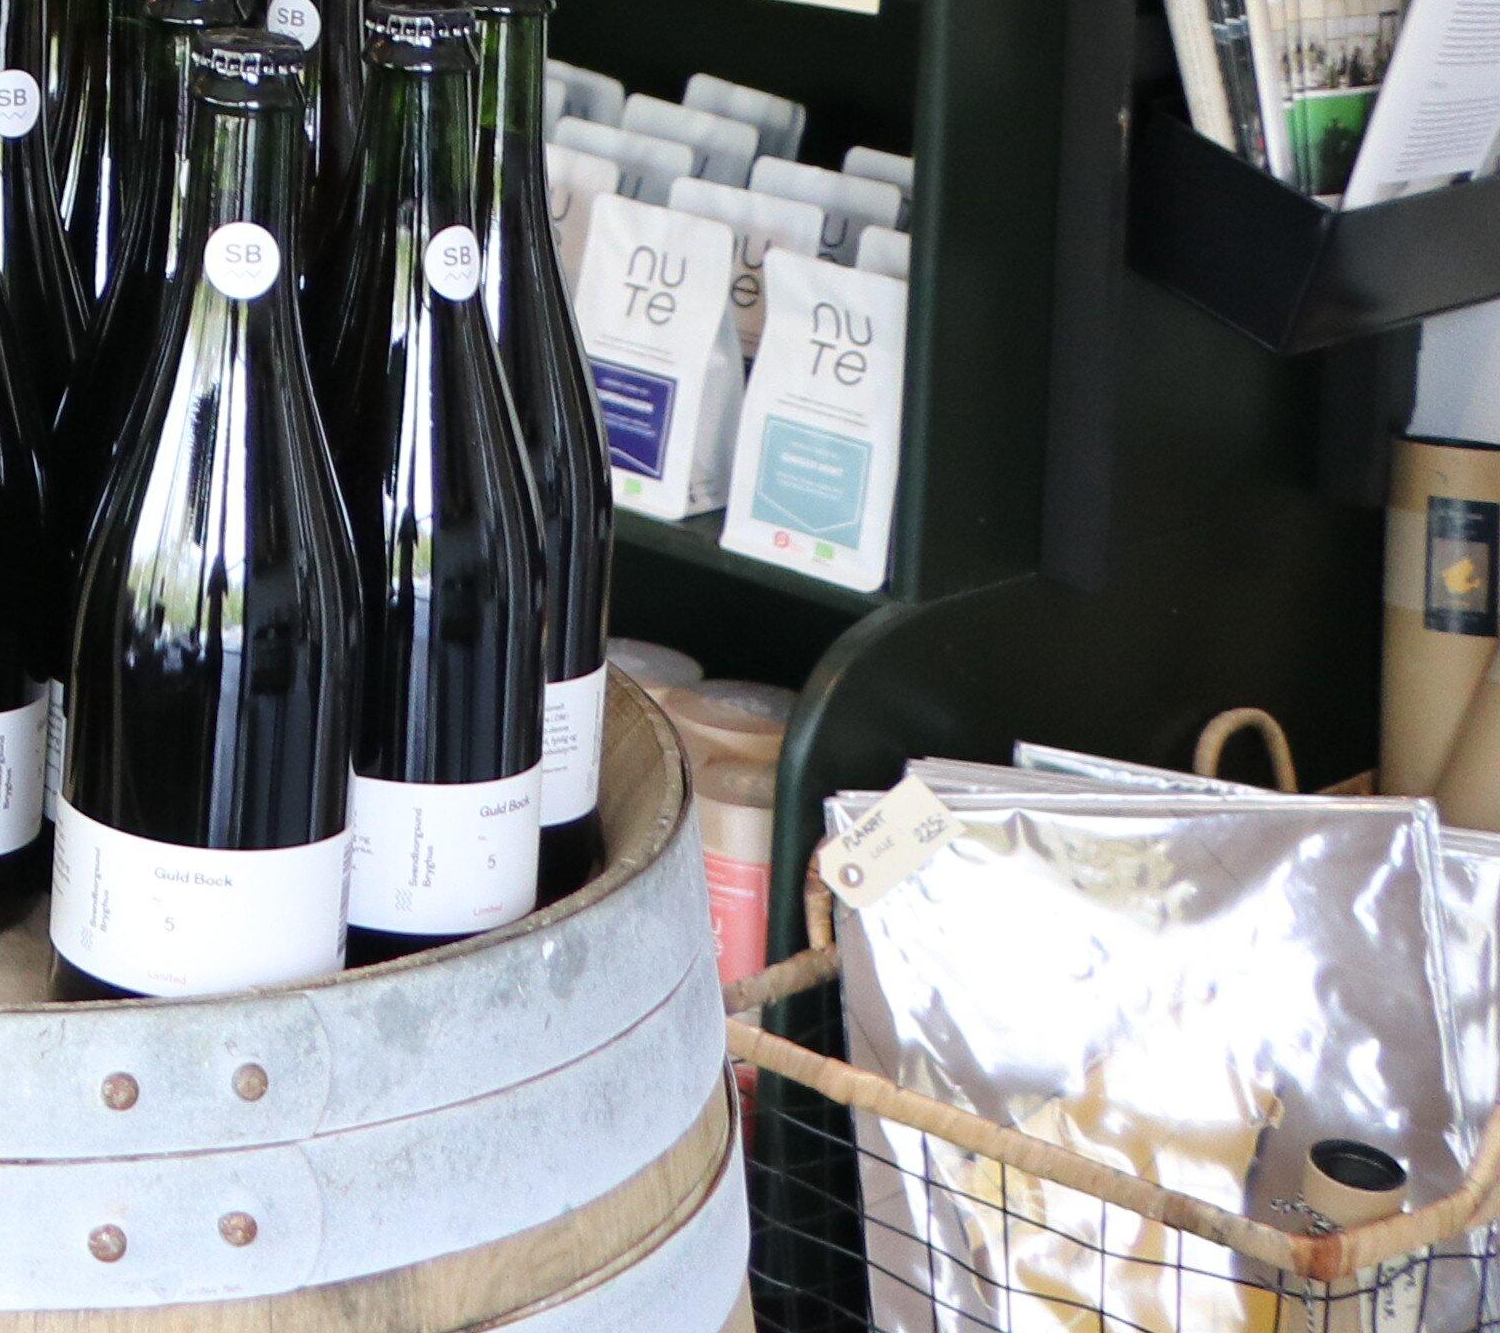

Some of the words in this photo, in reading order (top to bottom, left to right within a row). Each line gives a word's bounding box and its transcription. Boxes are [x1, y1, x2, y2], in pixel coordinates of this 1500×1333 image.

[276, 7, 305, 28] SB
[225, 243, 263, 264] SB
[444, 245, 472, 267] SB
[480, 803, 507, 818] Guld
[509, 796, 531, 812] Bock
[486, 853, 497, 869] 5
[154, 866, 190, 884] Guld
[194, 871, 234, 888] Bock
[164, 916, 176, 933] 5
